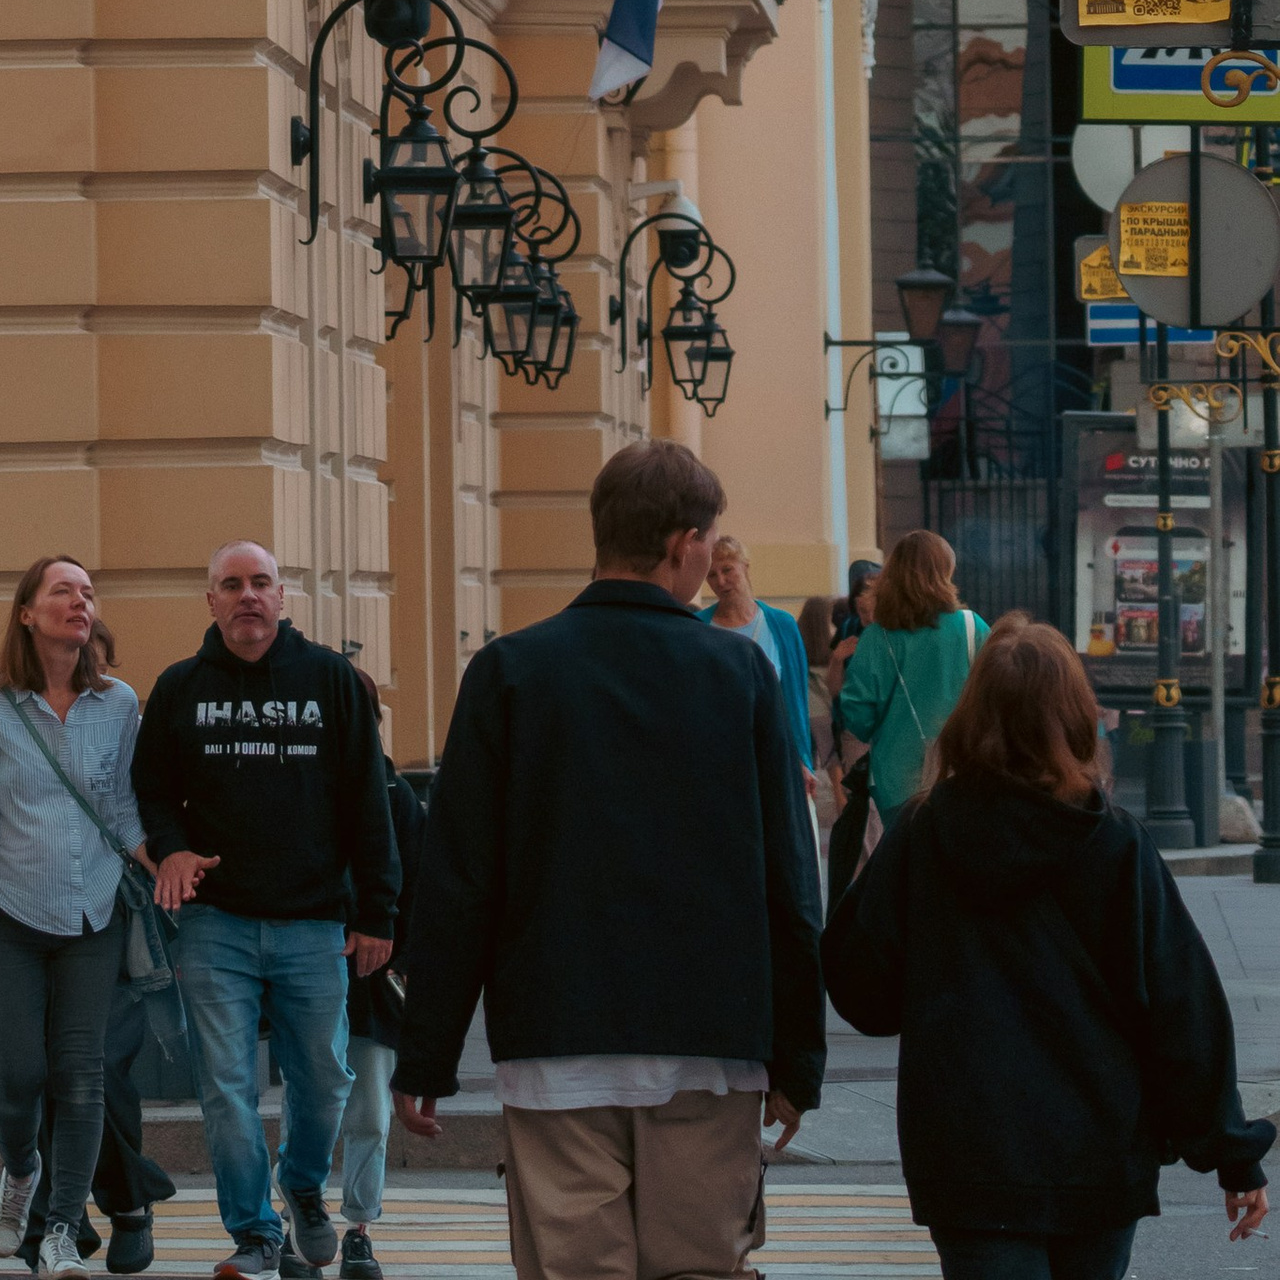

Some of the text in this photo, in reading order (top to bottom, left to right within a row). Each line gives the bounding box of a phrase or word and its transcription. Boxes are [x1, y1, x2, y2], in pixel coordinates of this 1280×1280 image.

[1127, 217, 1140, 226] ПО
[1130, 227, 1190, 237] ПАРАДНЫМ
[1128, 455, 1201, 469] СУТЧНО
[205, 744, 223, 755] BALI
[287, 745, 318, 756] KOMODO
